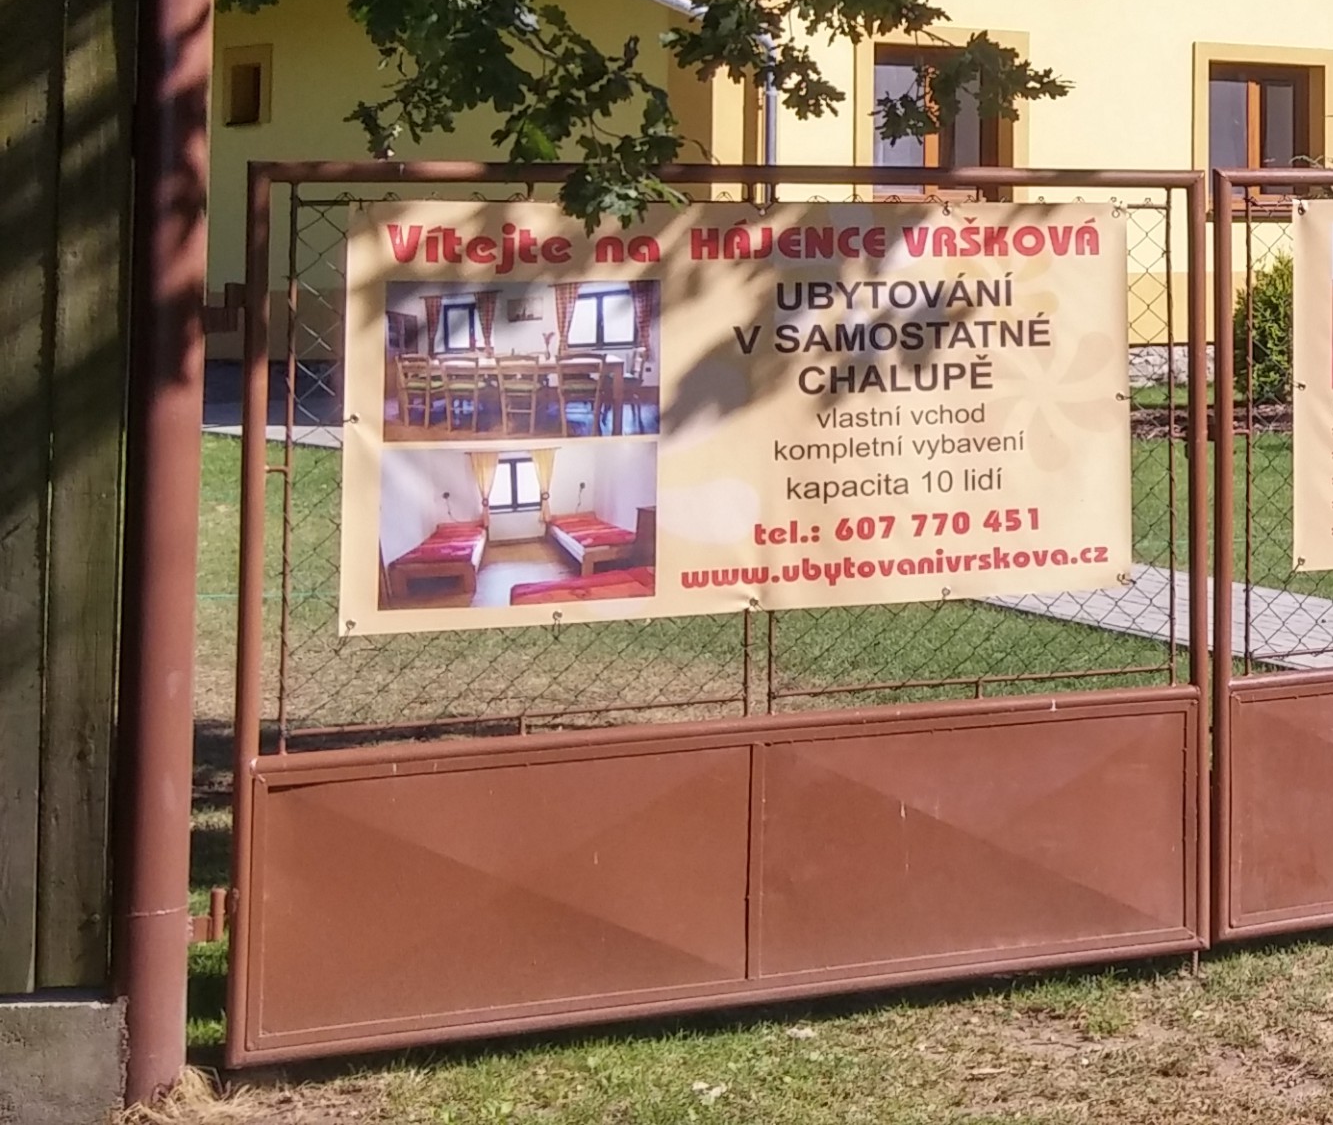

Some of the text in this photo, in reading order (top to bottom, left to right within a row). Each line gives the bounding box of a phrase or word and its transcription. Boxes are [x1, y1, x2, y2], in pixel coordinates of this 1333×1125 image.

[387, 217, 1100, 275] Vítejte na HÁJENCE VRŠKOVÁ
[776, 272, 1013, 311] UBYTOVÁNÍ
[733, 312, 1051, 354] V SAMOSTATNÉ
[798, 355, 994, 395] CHALUPĚ
[816, 403, 986, 429] vlastní vchod
[773, 430, 1025, 464] kompletní vybavení
[786, 467, 1003, 504] kapacita 10 lidí
[754, 507, 1041, 546] tel.: 607 770 451
[680, 545, 1110, 590] www.ubytovanivrskova.cz
